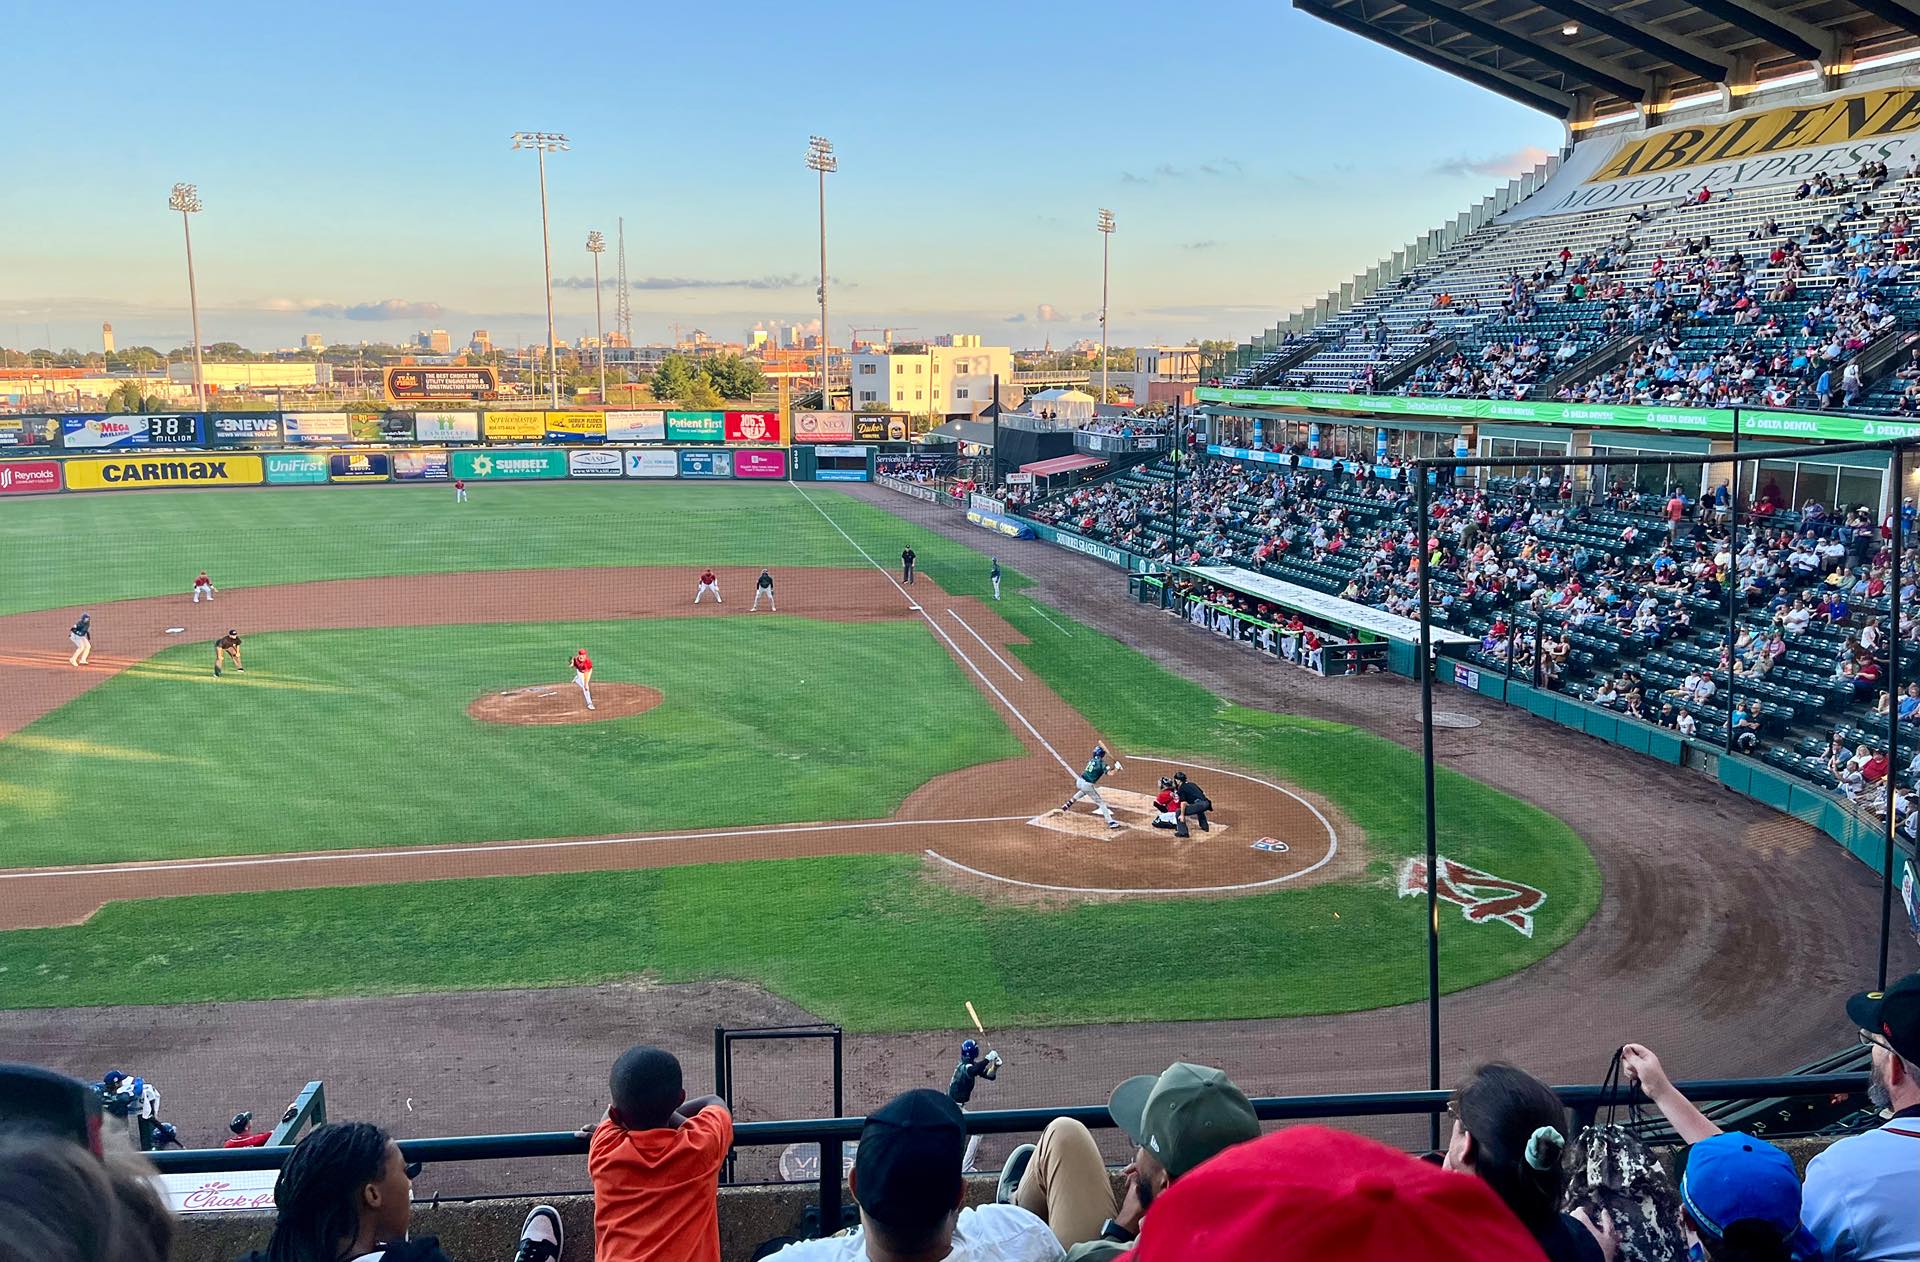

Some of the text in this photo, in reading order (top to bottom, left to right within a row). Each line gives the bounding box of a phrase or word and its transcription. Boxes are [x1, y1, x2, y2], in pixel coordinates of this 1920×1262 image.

[1589, 86, 1920, 183] ABILENE
[1552, 139, 1908, 211] MOTOR EXPRESS
[101, 422, 129, 432] MEGA
[669, 418, 722, 428] Patient First
[1757, 420, 1819, 432] DELTA DENTAL
[1877, 425, 1905, 435] DELTA
[269, 459, 324, 471] UniFirst
[14, 470, 54, 481] Reynolds
